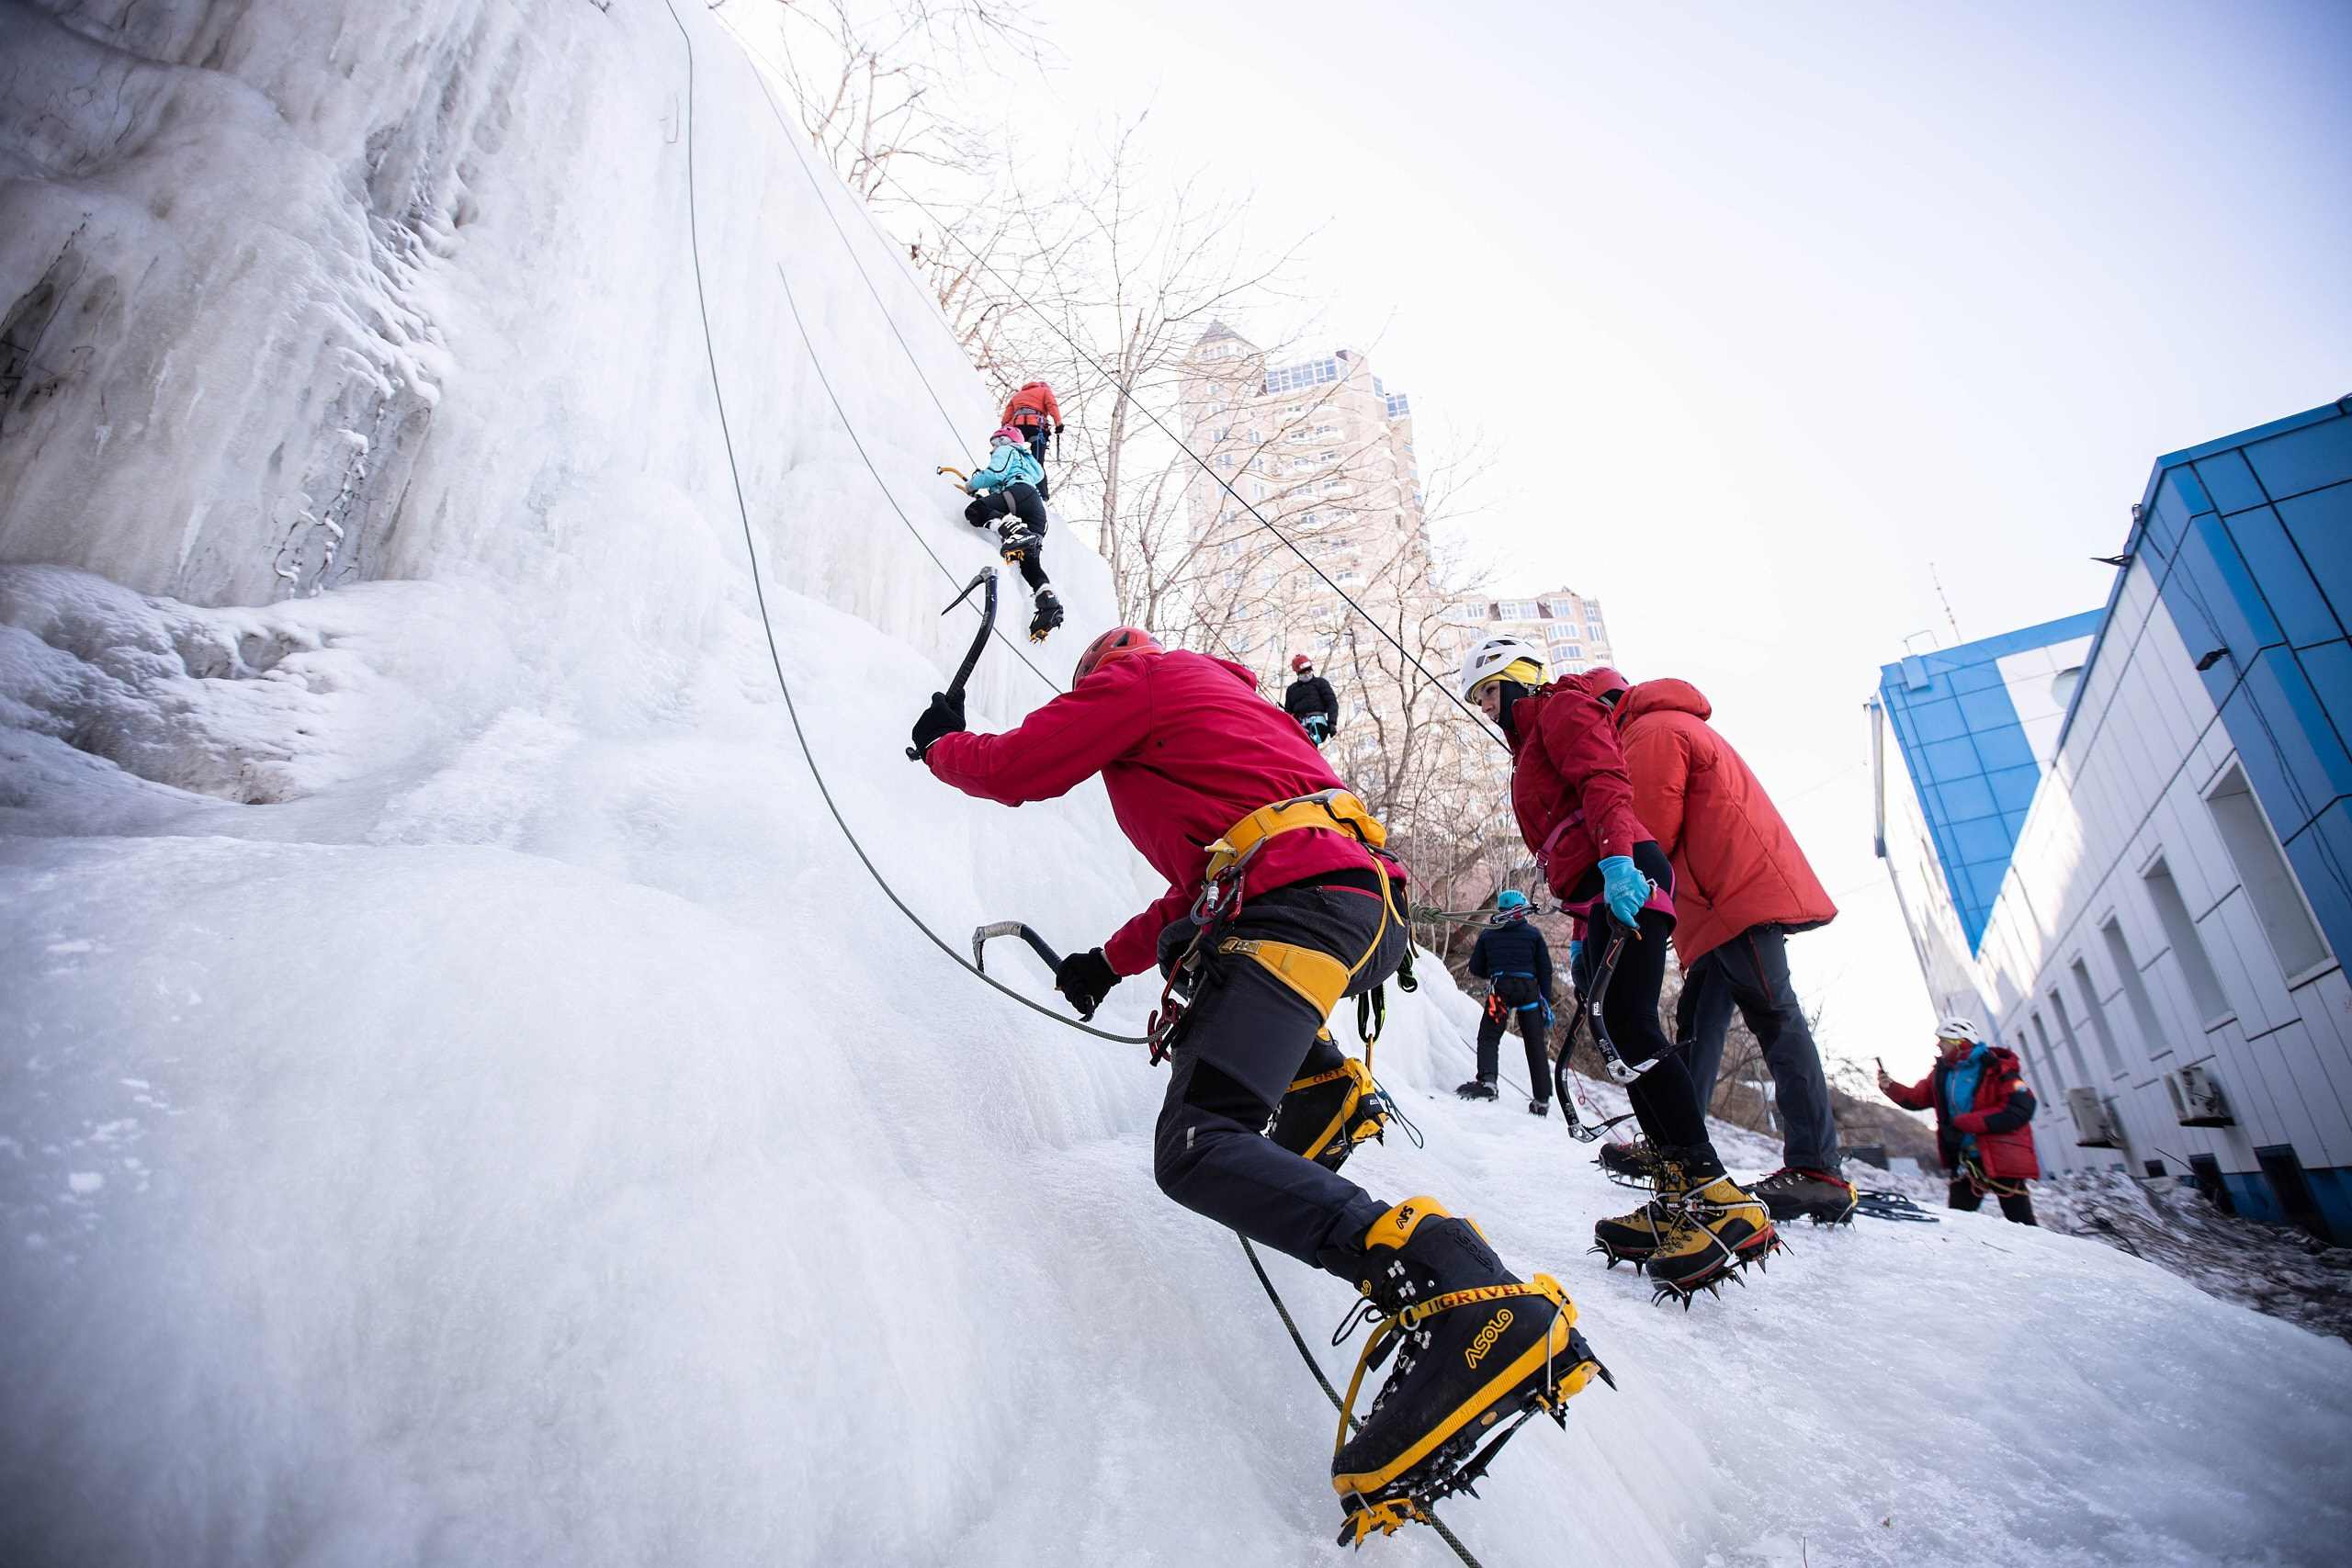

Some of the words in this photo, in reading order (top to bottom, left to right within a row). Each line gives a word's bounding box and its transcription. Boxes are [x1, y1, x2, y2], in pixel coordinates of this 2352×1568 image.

[1396, 1205, 1414, 1230] AFS
[1444, 1227, 1496, 1273] ASOLO
[1439, 1284, 1532, 1309] GRIVEL
[1464, 1308, 1514, 1370] ASOLO
